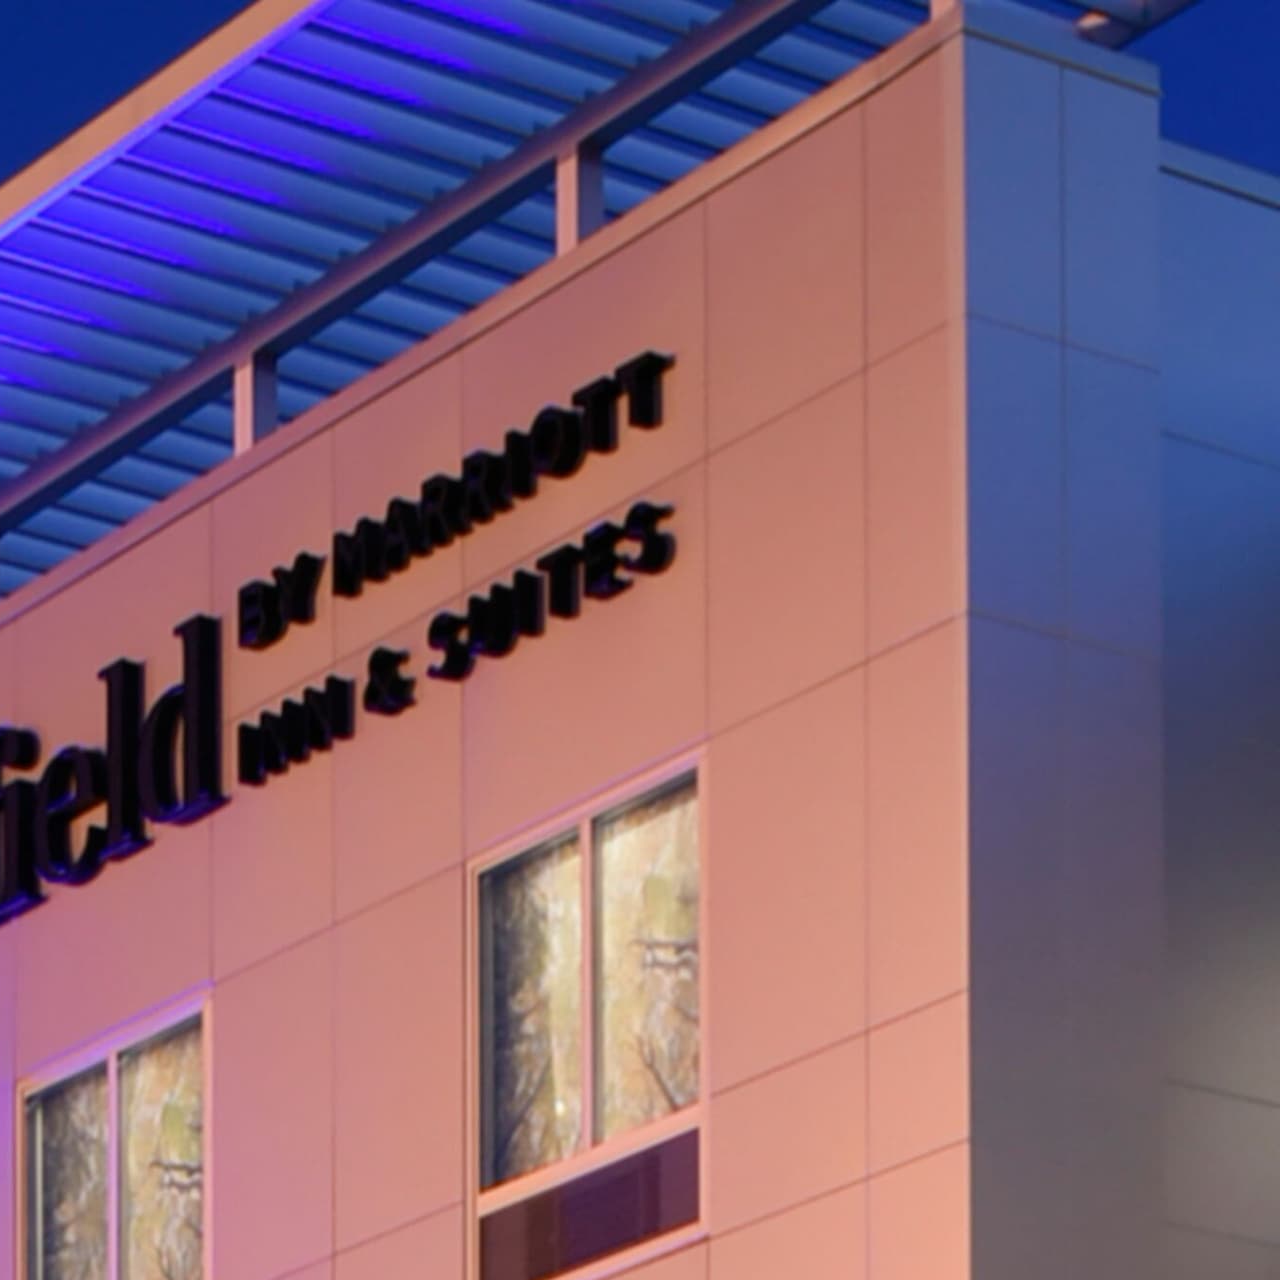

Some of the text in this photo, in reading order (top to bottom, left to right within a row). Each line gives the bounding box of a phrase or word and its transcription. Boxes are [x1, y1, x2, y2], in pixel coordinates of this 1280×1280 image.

[238, 350, 676, 650] BY MARRIOTT
[238, 501, 677, 786] INN & SUITES
